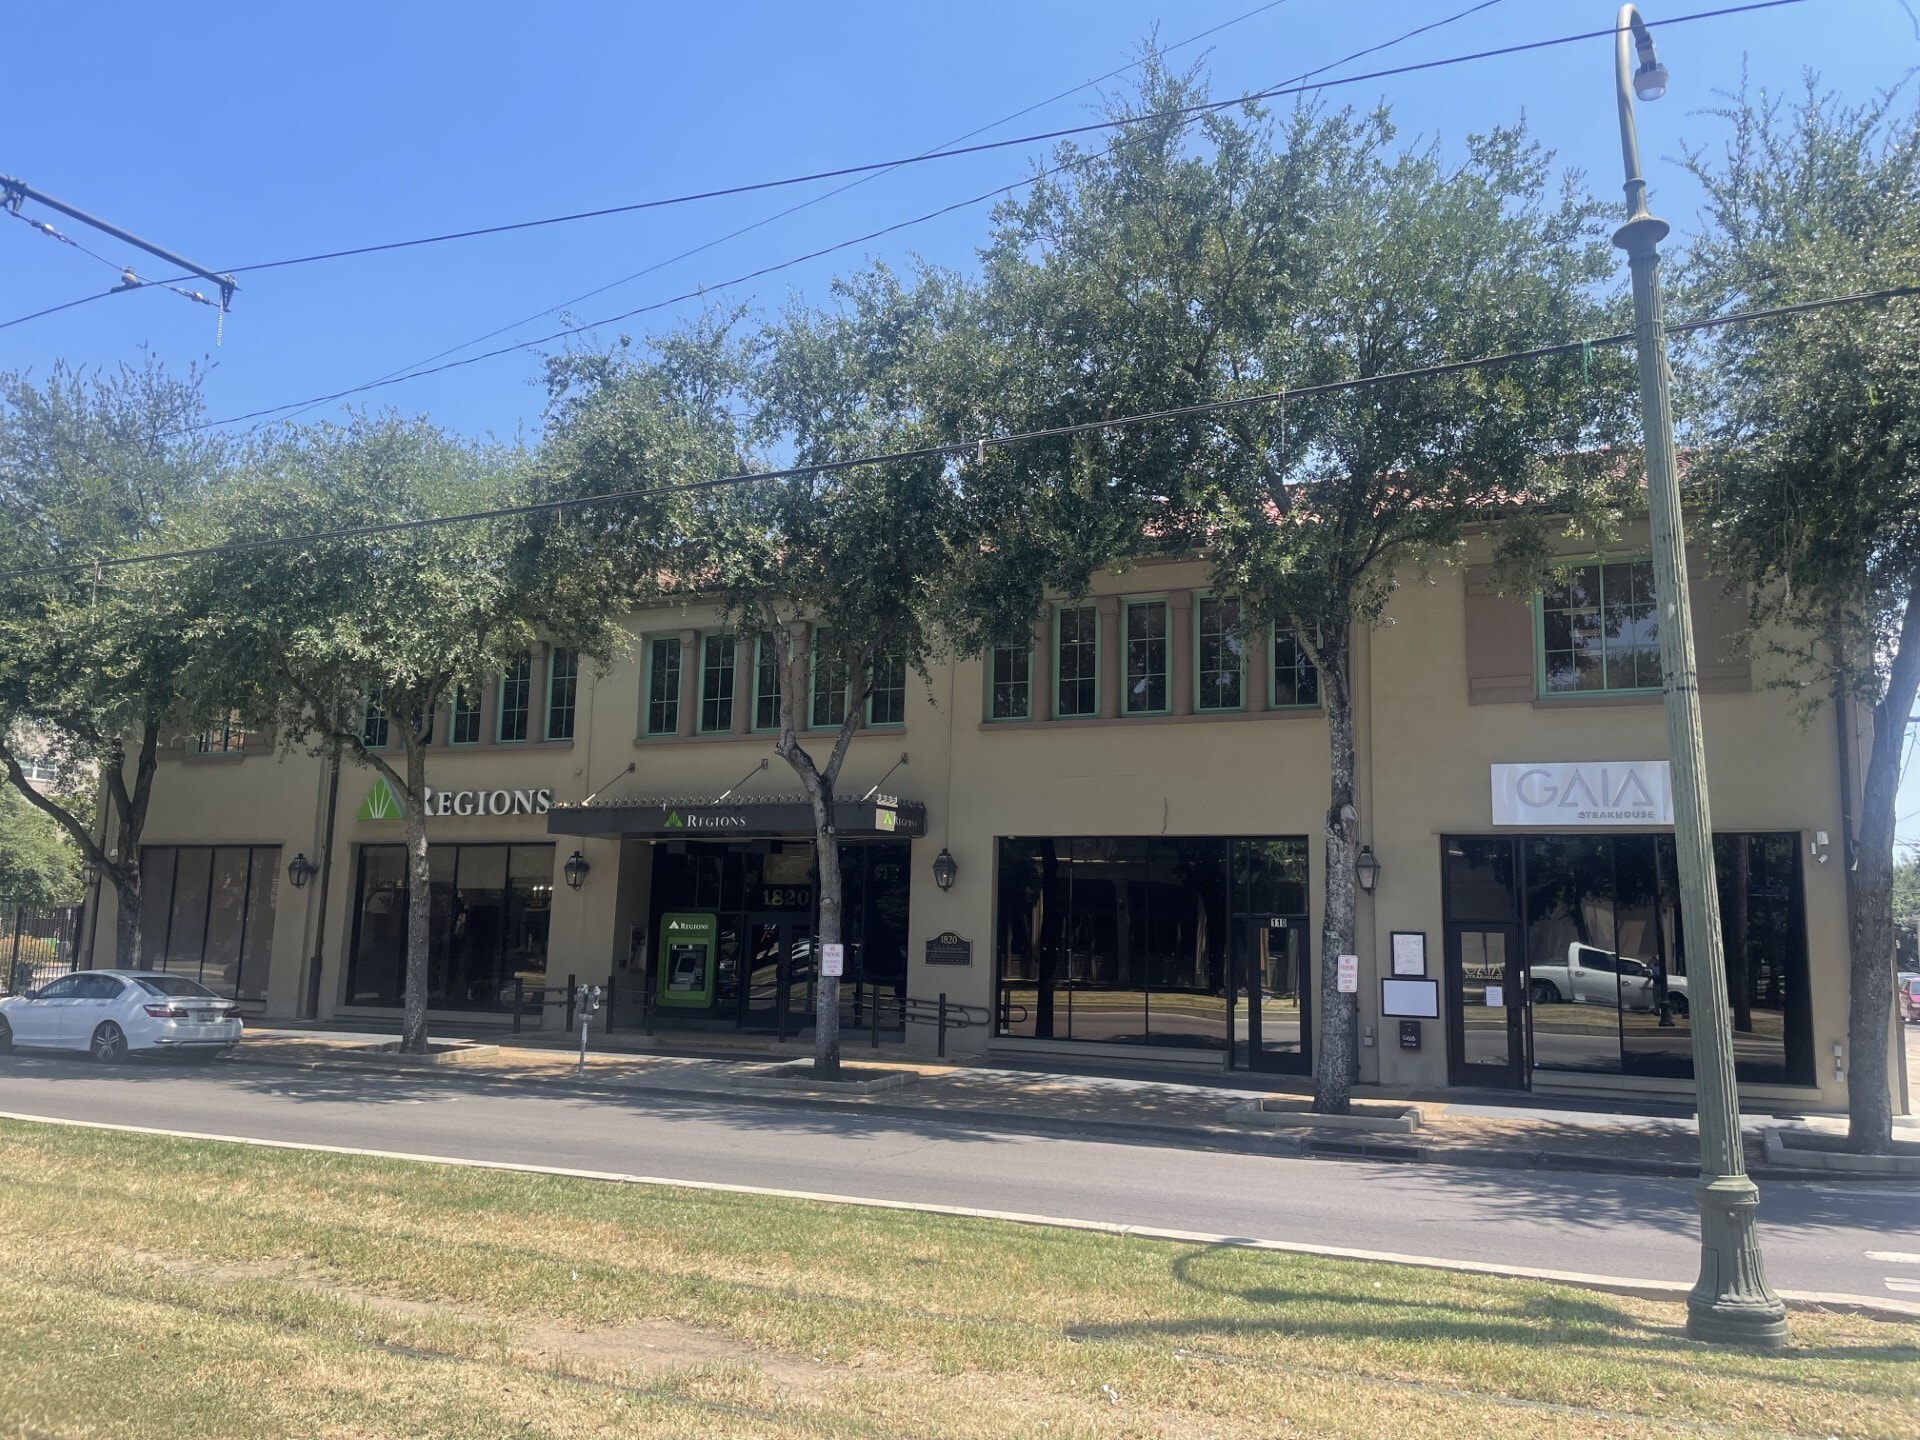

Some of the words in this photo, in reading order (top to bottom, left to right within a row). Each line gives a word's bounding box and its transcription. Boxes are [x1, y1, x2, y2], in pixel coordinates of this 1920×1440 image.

[1516, 768, 1655, 808] GAIA
[687, 814, 746, 827] REGIONS
[1578, 811, 1655, 819] STEAKHOUSE
[761, 889, 810, 906] 1820
[681, 922, 709, 930] REGIONS
[941, 935, 958, 945] 1820
